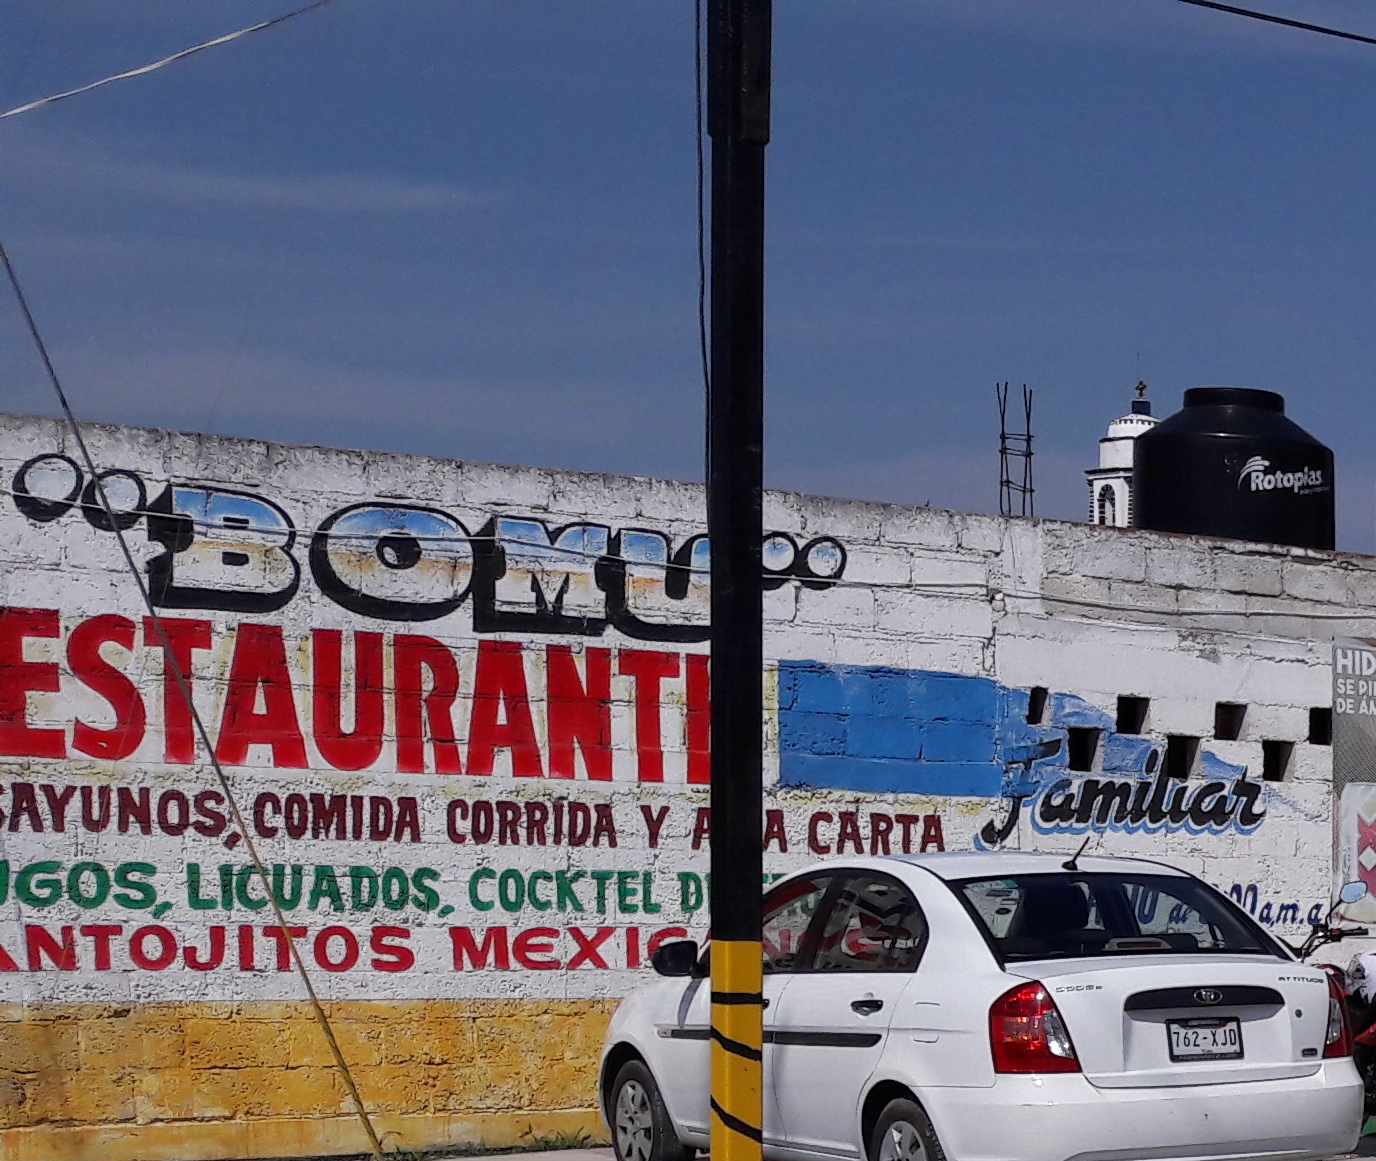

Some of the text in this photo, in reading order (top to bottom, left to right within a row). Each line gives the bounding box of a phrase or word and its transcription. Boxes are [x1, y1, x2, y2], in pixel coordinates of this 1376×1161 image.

[1250, 465, 1324, 494] Rotoplas
[1336, 678, 1355, 696] SE
[1336, 696, 1355, 715] DE
[253, 796, 422, 844] COMIDA
[446, 798, 618, 850] CORRIDA
[640, 804, 670, 850] Y
[807, 811, 945, 856] CARTA
[0, 858, 174, 919] GOS,
[187, 862, 454, 917] LICUADOS,
[468, 867, 662, 916] COCKTEL
[1172, 1028, 1237, 1048] 762-XJD
